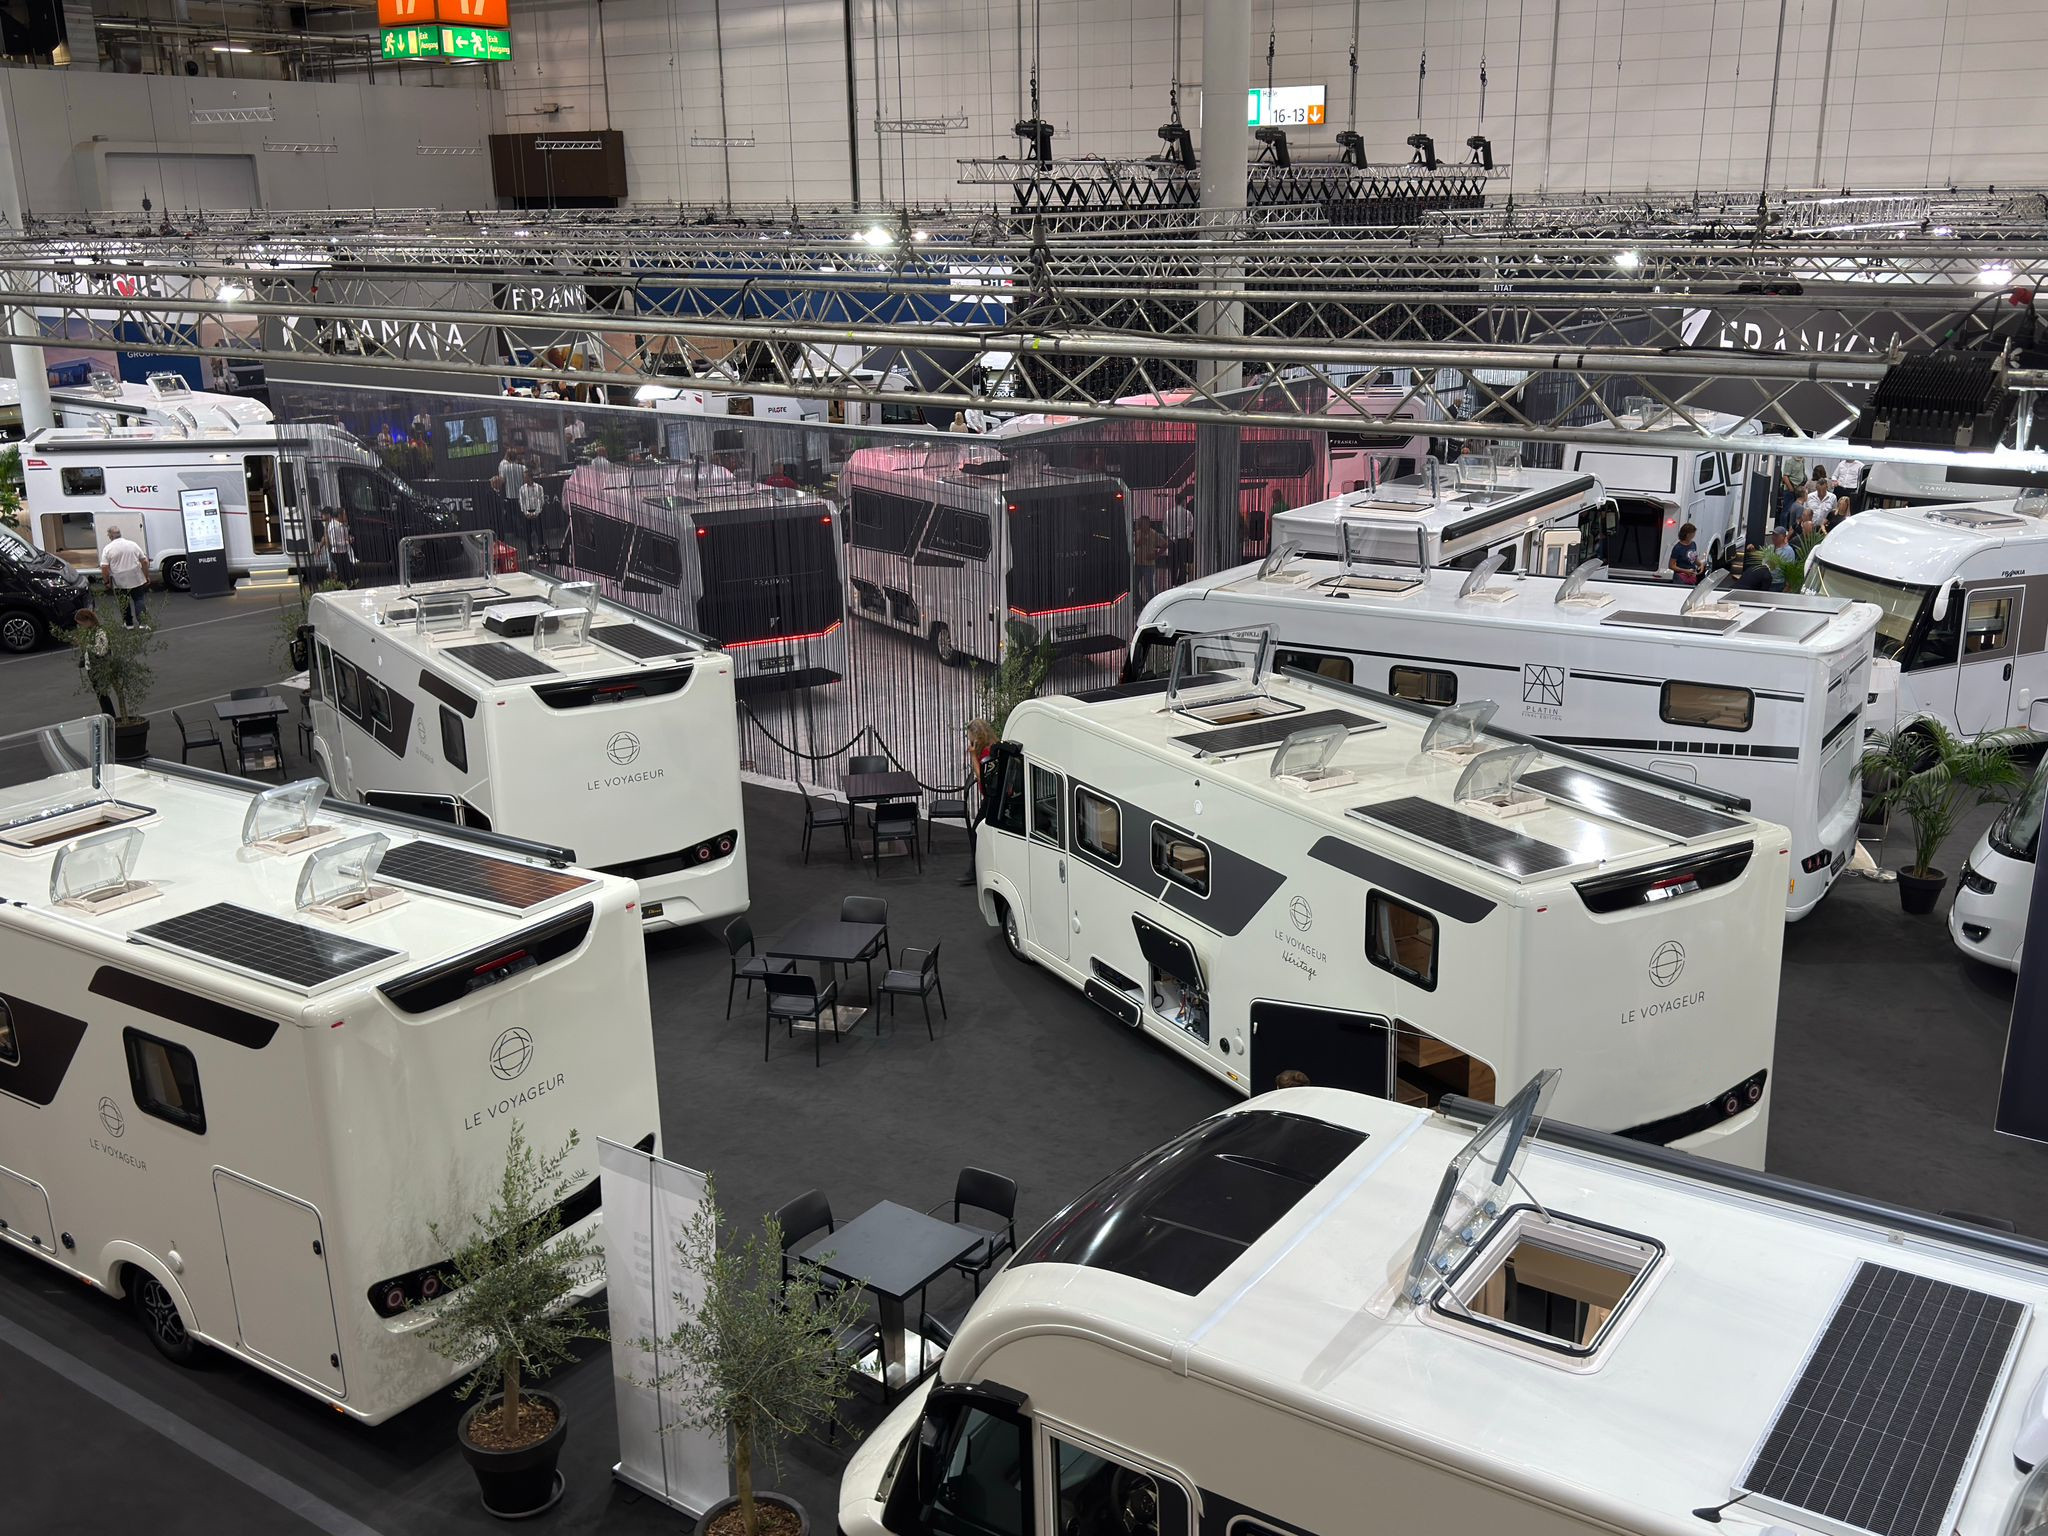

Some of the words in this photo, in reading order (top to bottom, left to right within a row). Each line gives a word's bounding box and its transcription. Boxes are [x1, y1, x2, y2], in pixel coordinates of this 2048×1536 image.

[421, 42, 438, 50] Ausgang
[489, 45, 510, 54] Ausgang
[1526, 705, 1559, 715] PLATIN
[587, 780, 600, 791] LE
[604, 769, 664, 787] VOYAGEUR
[1274, 929, 1284, 941] LE
[1286, 934, 1327, 963] VOYAGEUR
[1282, 949, 1317, 981] Héritage
[1621, 1010, 1636, 1024] LE
[1640, 991, 1705, 1018] VOYAGEUR
[464, 1112, 482, 1130] LE
[487, 1073, 565, 1118] VOYAGEUR
[90, 1137, 100, 1150] LE
[101, 1143, 147, 1171] VOYAGEUR
